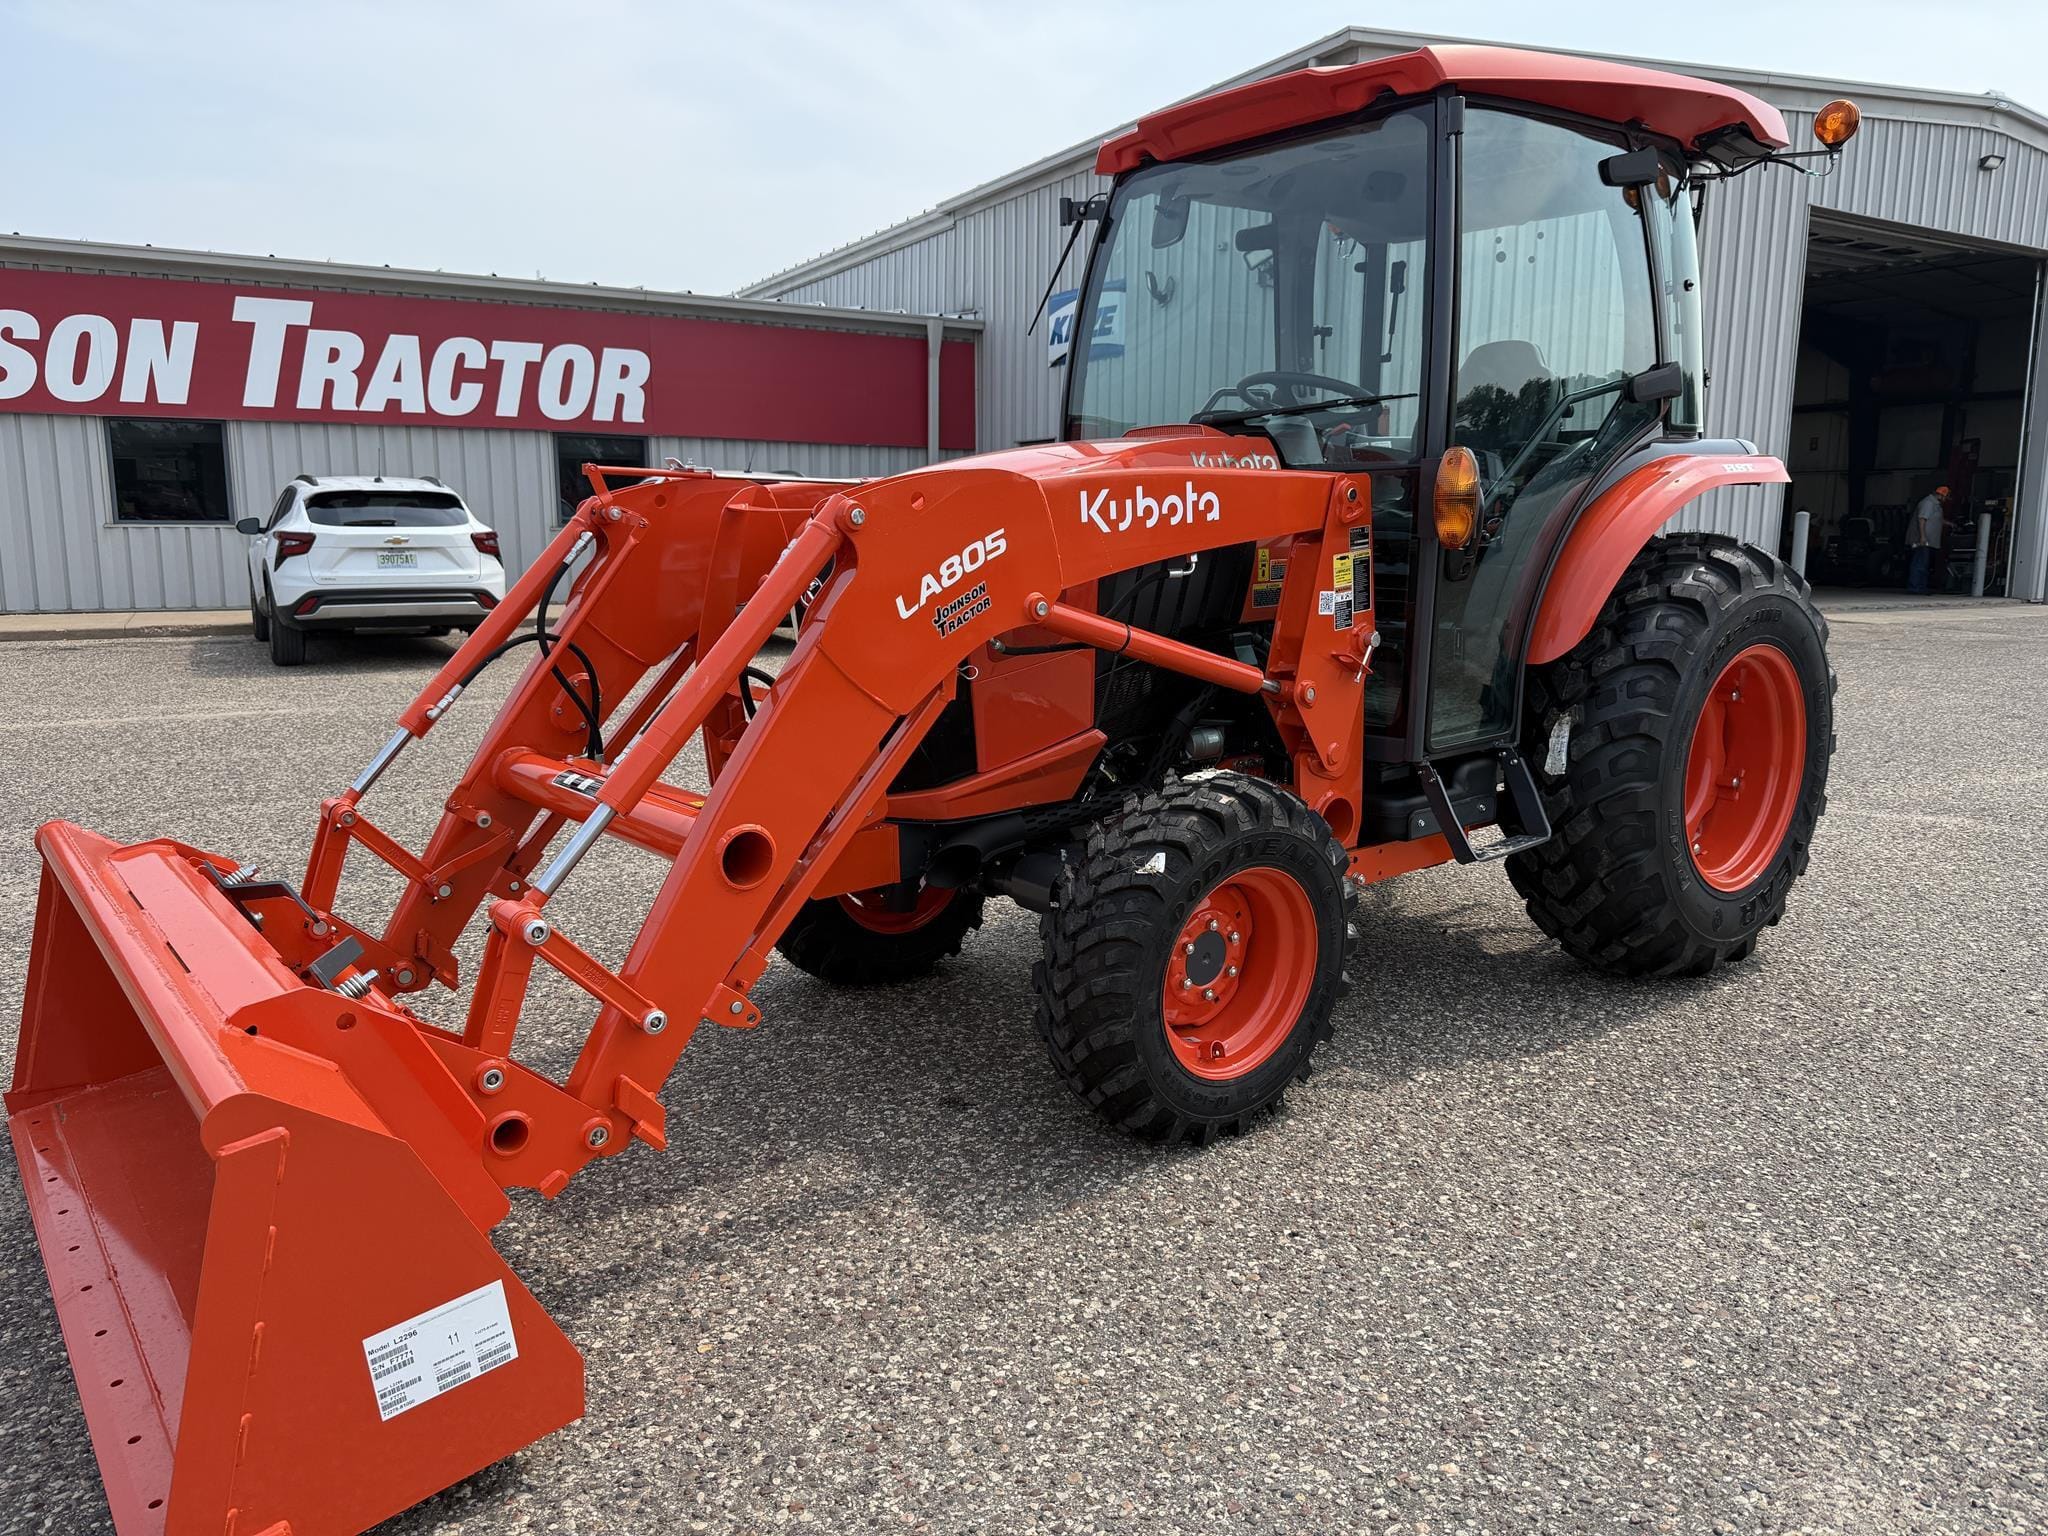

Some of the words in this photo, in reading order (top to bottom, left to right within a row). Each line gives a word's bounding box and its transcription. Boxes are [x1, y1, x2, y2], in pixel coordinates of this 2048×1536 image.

[232, 296, 651, 423] TRACTOR
[1080, 481, 1220, 533] Kubota
[895, 528, 1008, 620] LA805
[933, 582, 986, 625] JOHNSON
[937, 597, 991, 638] TRACTOR
[367, 1342, 390, 1356] Model
[393, 1329, 418, 1344] L2296
[448, 1331, 460, 1345] 11
[372, 1363, 385, 1373] S/N
[390, 1350, 414, 1365] F7771
